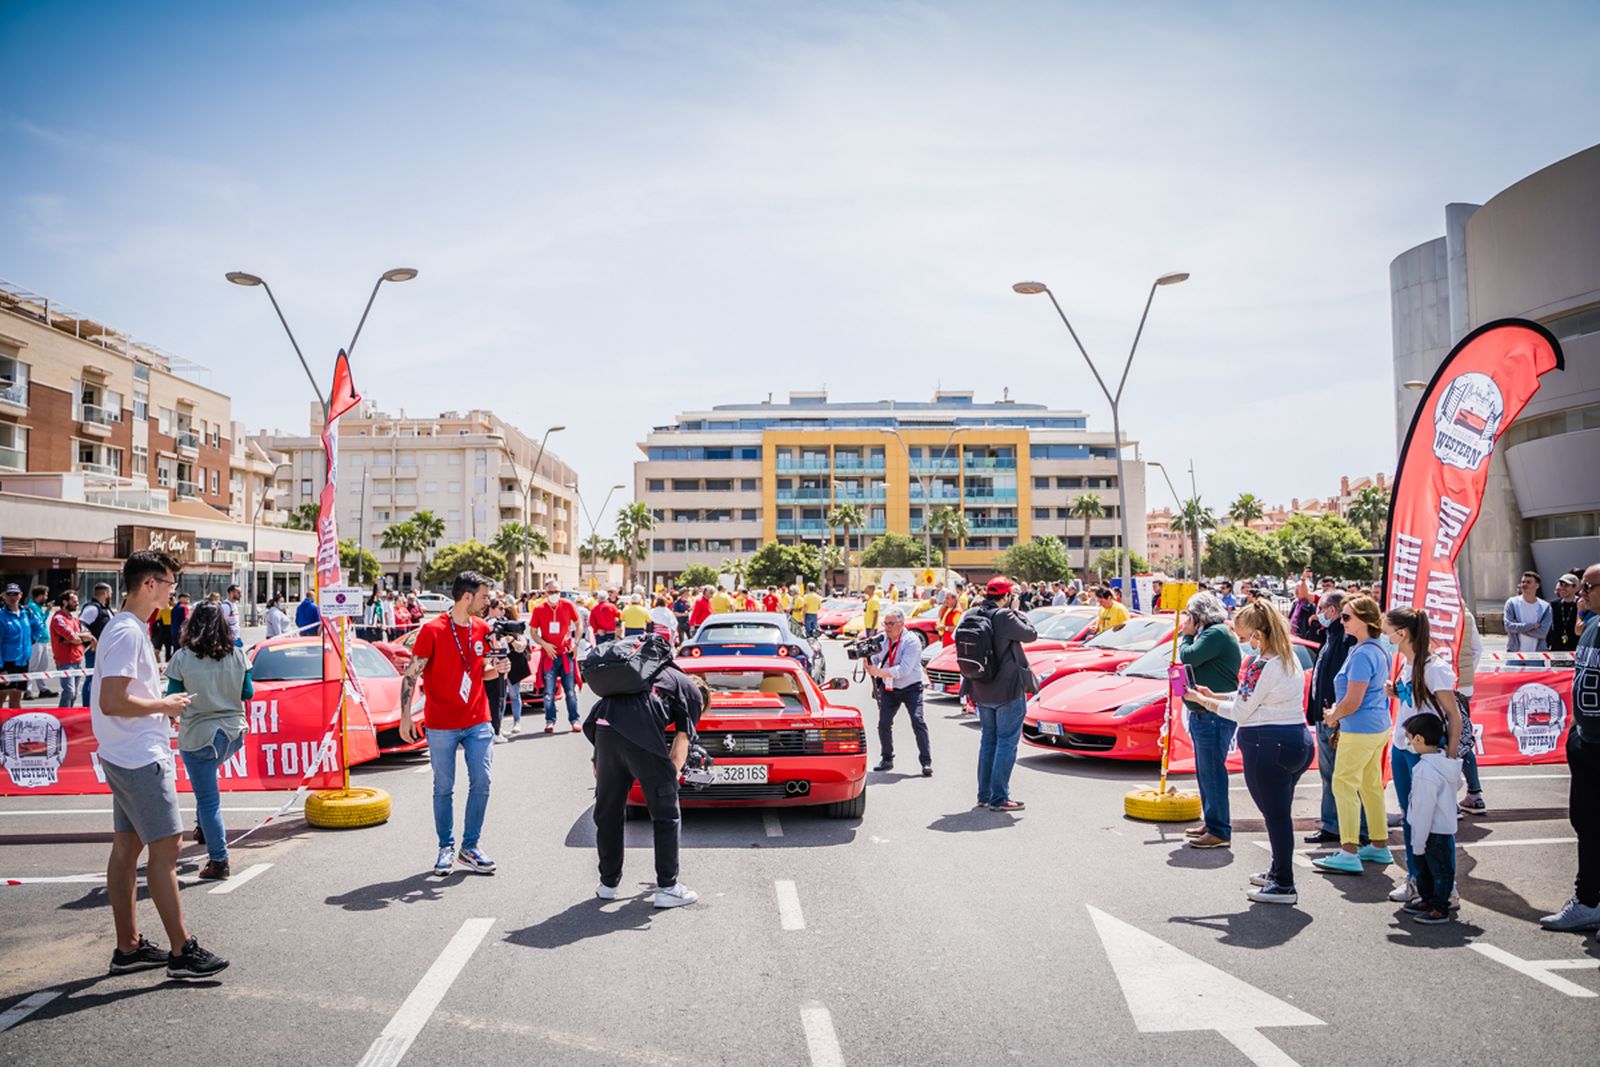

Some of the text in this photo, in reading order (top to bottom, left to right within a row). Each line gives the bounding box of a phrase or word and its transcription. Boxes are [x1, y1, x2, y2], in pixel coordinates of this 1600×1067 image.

[1435, 430, 1482, 467] WESTERN
[1519, 734, 1557, 750] WESTERN
[261, 739, 340, 777] TOUR
[10, 767, 56, 782] WESTERN
